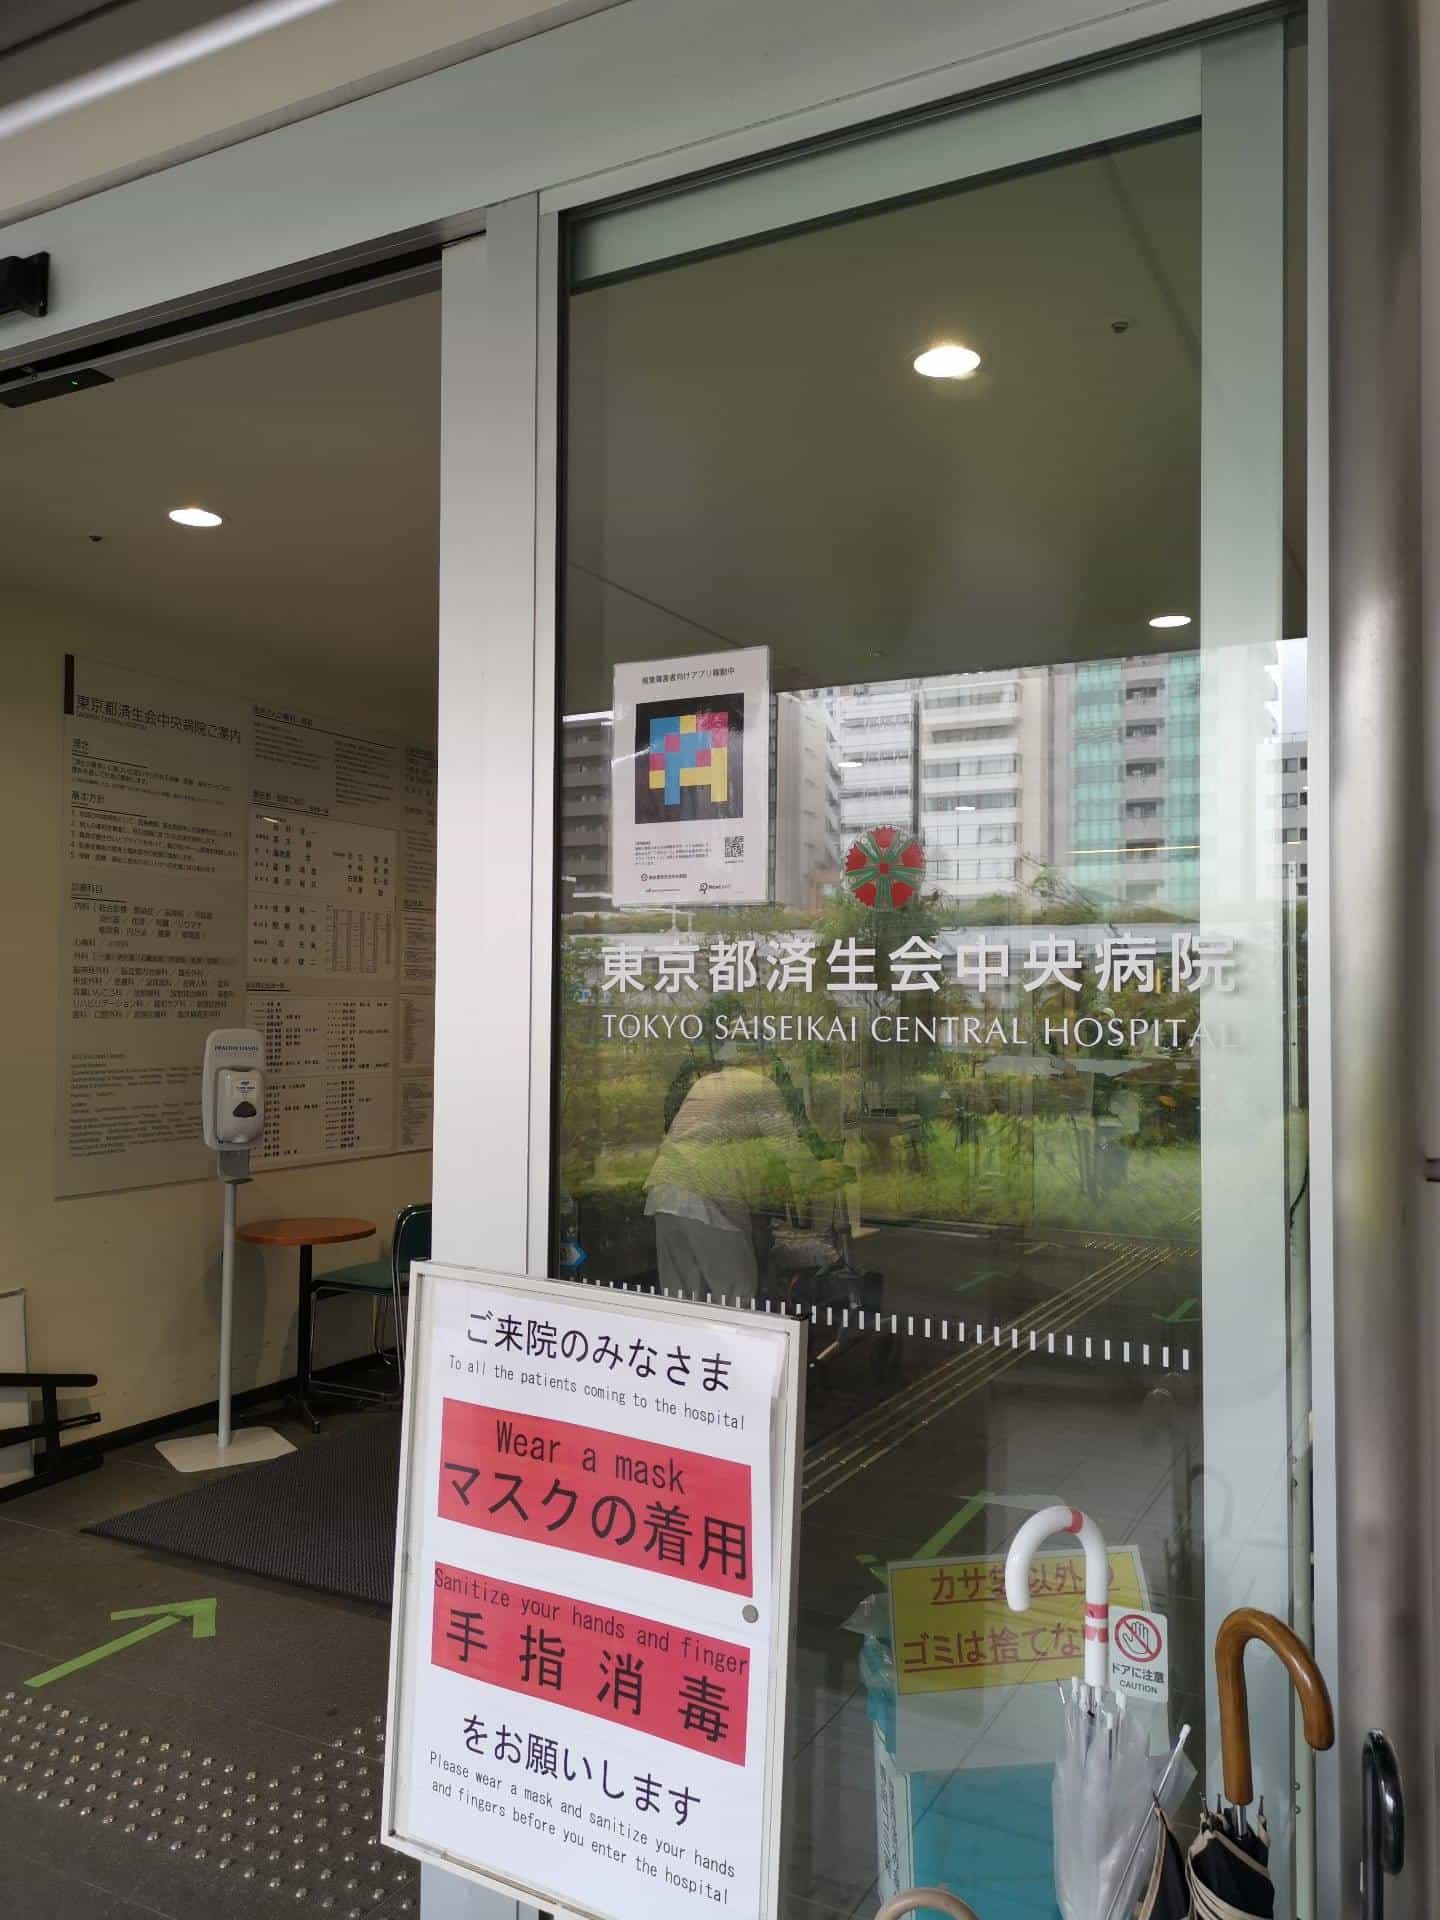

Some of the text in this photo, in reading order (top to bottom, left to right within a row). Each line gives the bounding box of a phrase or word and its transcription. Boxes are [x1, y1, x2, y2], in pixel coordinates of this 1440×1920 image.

[601, 932, 1236, 994] 東京都済生会中央病院
[602, 1014, 704, 1041] TOKYO
[715, 1013, 857, 1042] SAISEIKAI
[871, 1014, 1027, 1045] CENTRAL
[467, 1309, 733, 1392] ご来院のみなさま
[449, 1354, 745, 1431] To all the patients coming to the hospital
[496, 1419, 685, 1494] Wear a mask
[443, 1461, 749, 1581] マスクの着用
[435, 1568, 748, 1676] Sanitize your hands and finger
[1112, 1662, 1164, 1684] ドアに注意
[1119, 1680, 1158, 1694] CAUTION
[463, 1713, 700, 1827] をお願いします
[430, 1750, 735, 1878] Please wear a mask and sanitize your hands
[431, 1777, 729, 1904] and fingers before you enter the hospital
